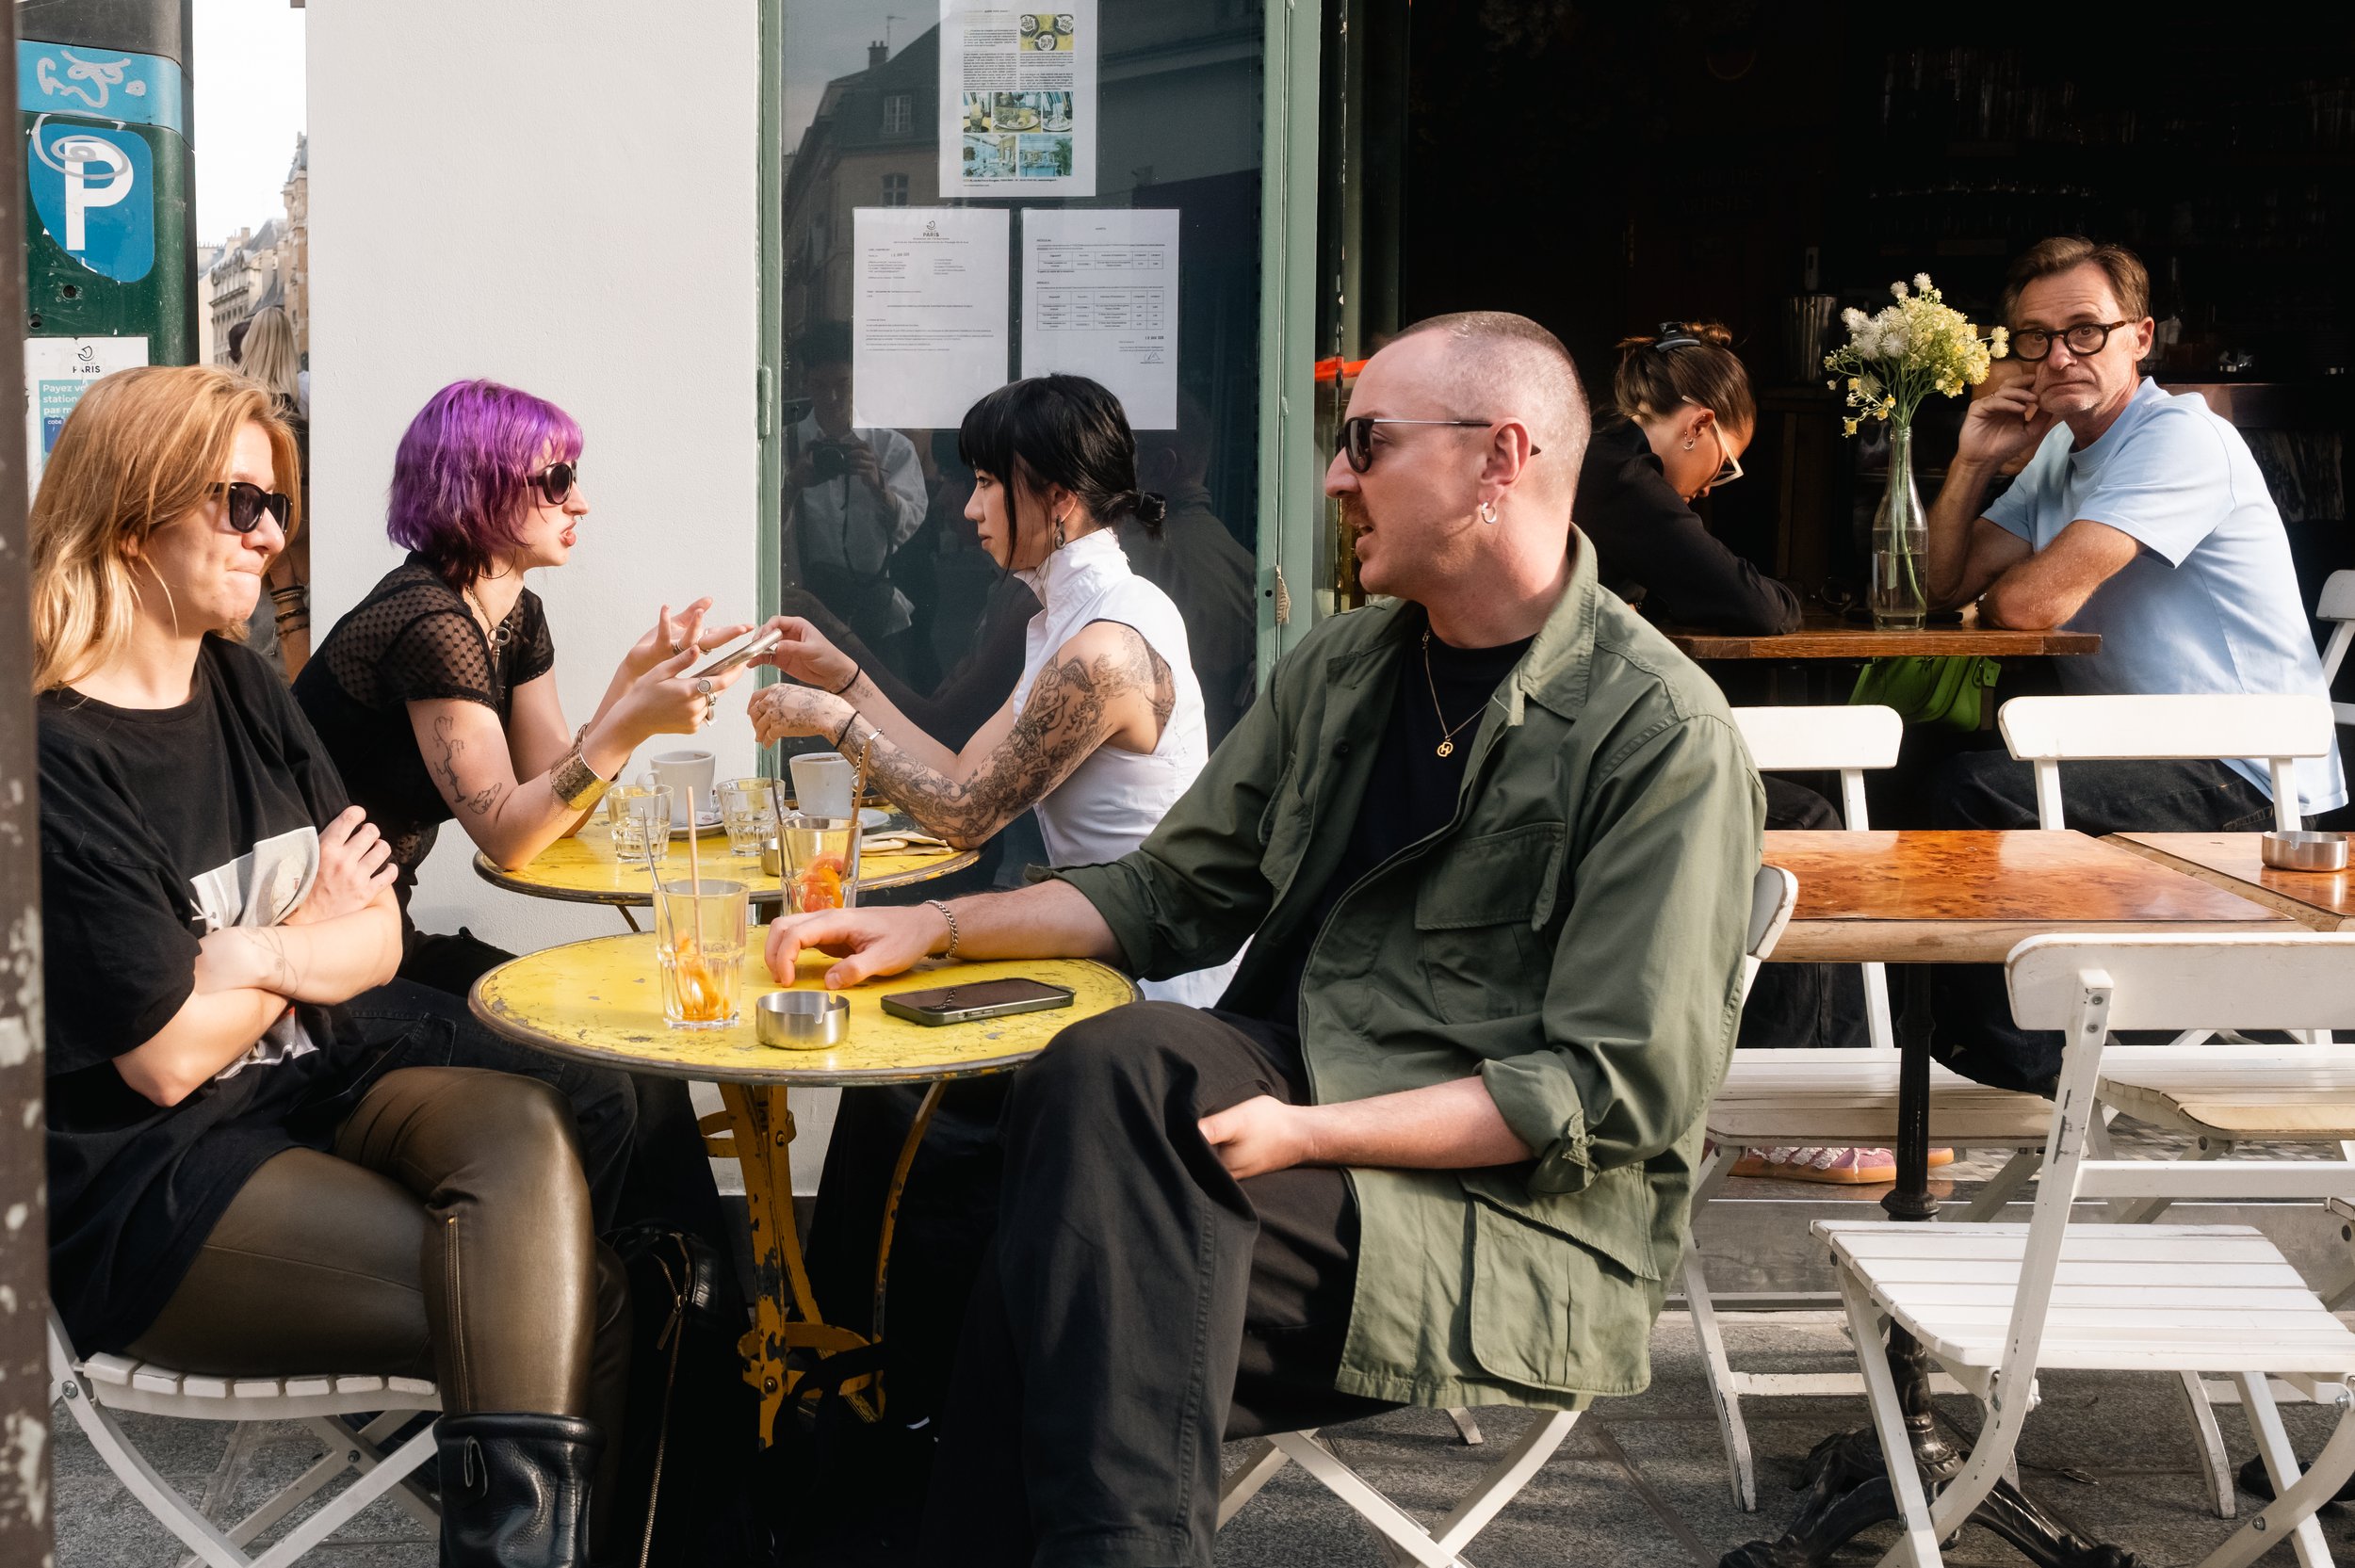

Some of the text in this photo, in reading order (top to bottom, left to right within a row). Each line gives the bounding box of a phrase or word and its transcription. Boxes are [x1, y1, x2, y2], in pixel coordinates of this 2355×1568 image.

[65, 142, 134, 251] P
[42, 384, 72, 394] Payez
[42, 395, 77, 403] station
[43, 407, 61, 416] par
